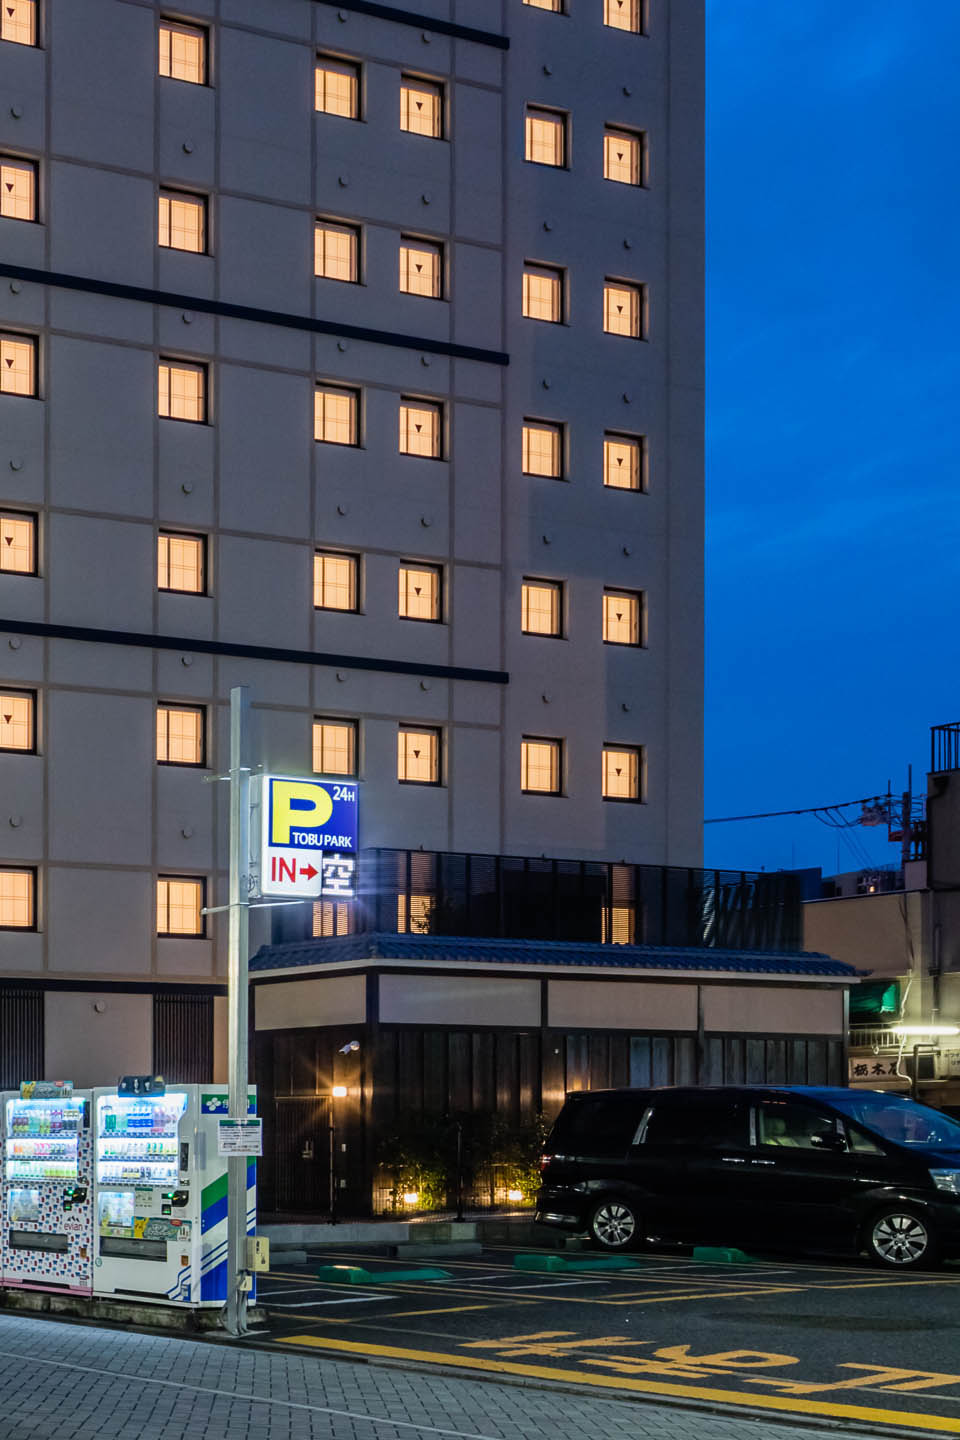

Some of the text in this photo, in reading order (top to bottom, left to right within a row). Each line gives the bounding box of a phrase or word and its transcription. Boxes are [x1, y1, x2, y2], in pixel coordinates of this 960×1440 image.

[332, 785, 356, 802] 24H
[272, 780, 333, 844] P
[292, 831, 353, 848] TOBU PARK
[271, 856, 297, 883] IN
[63, 1223, 84, 1232] evian
